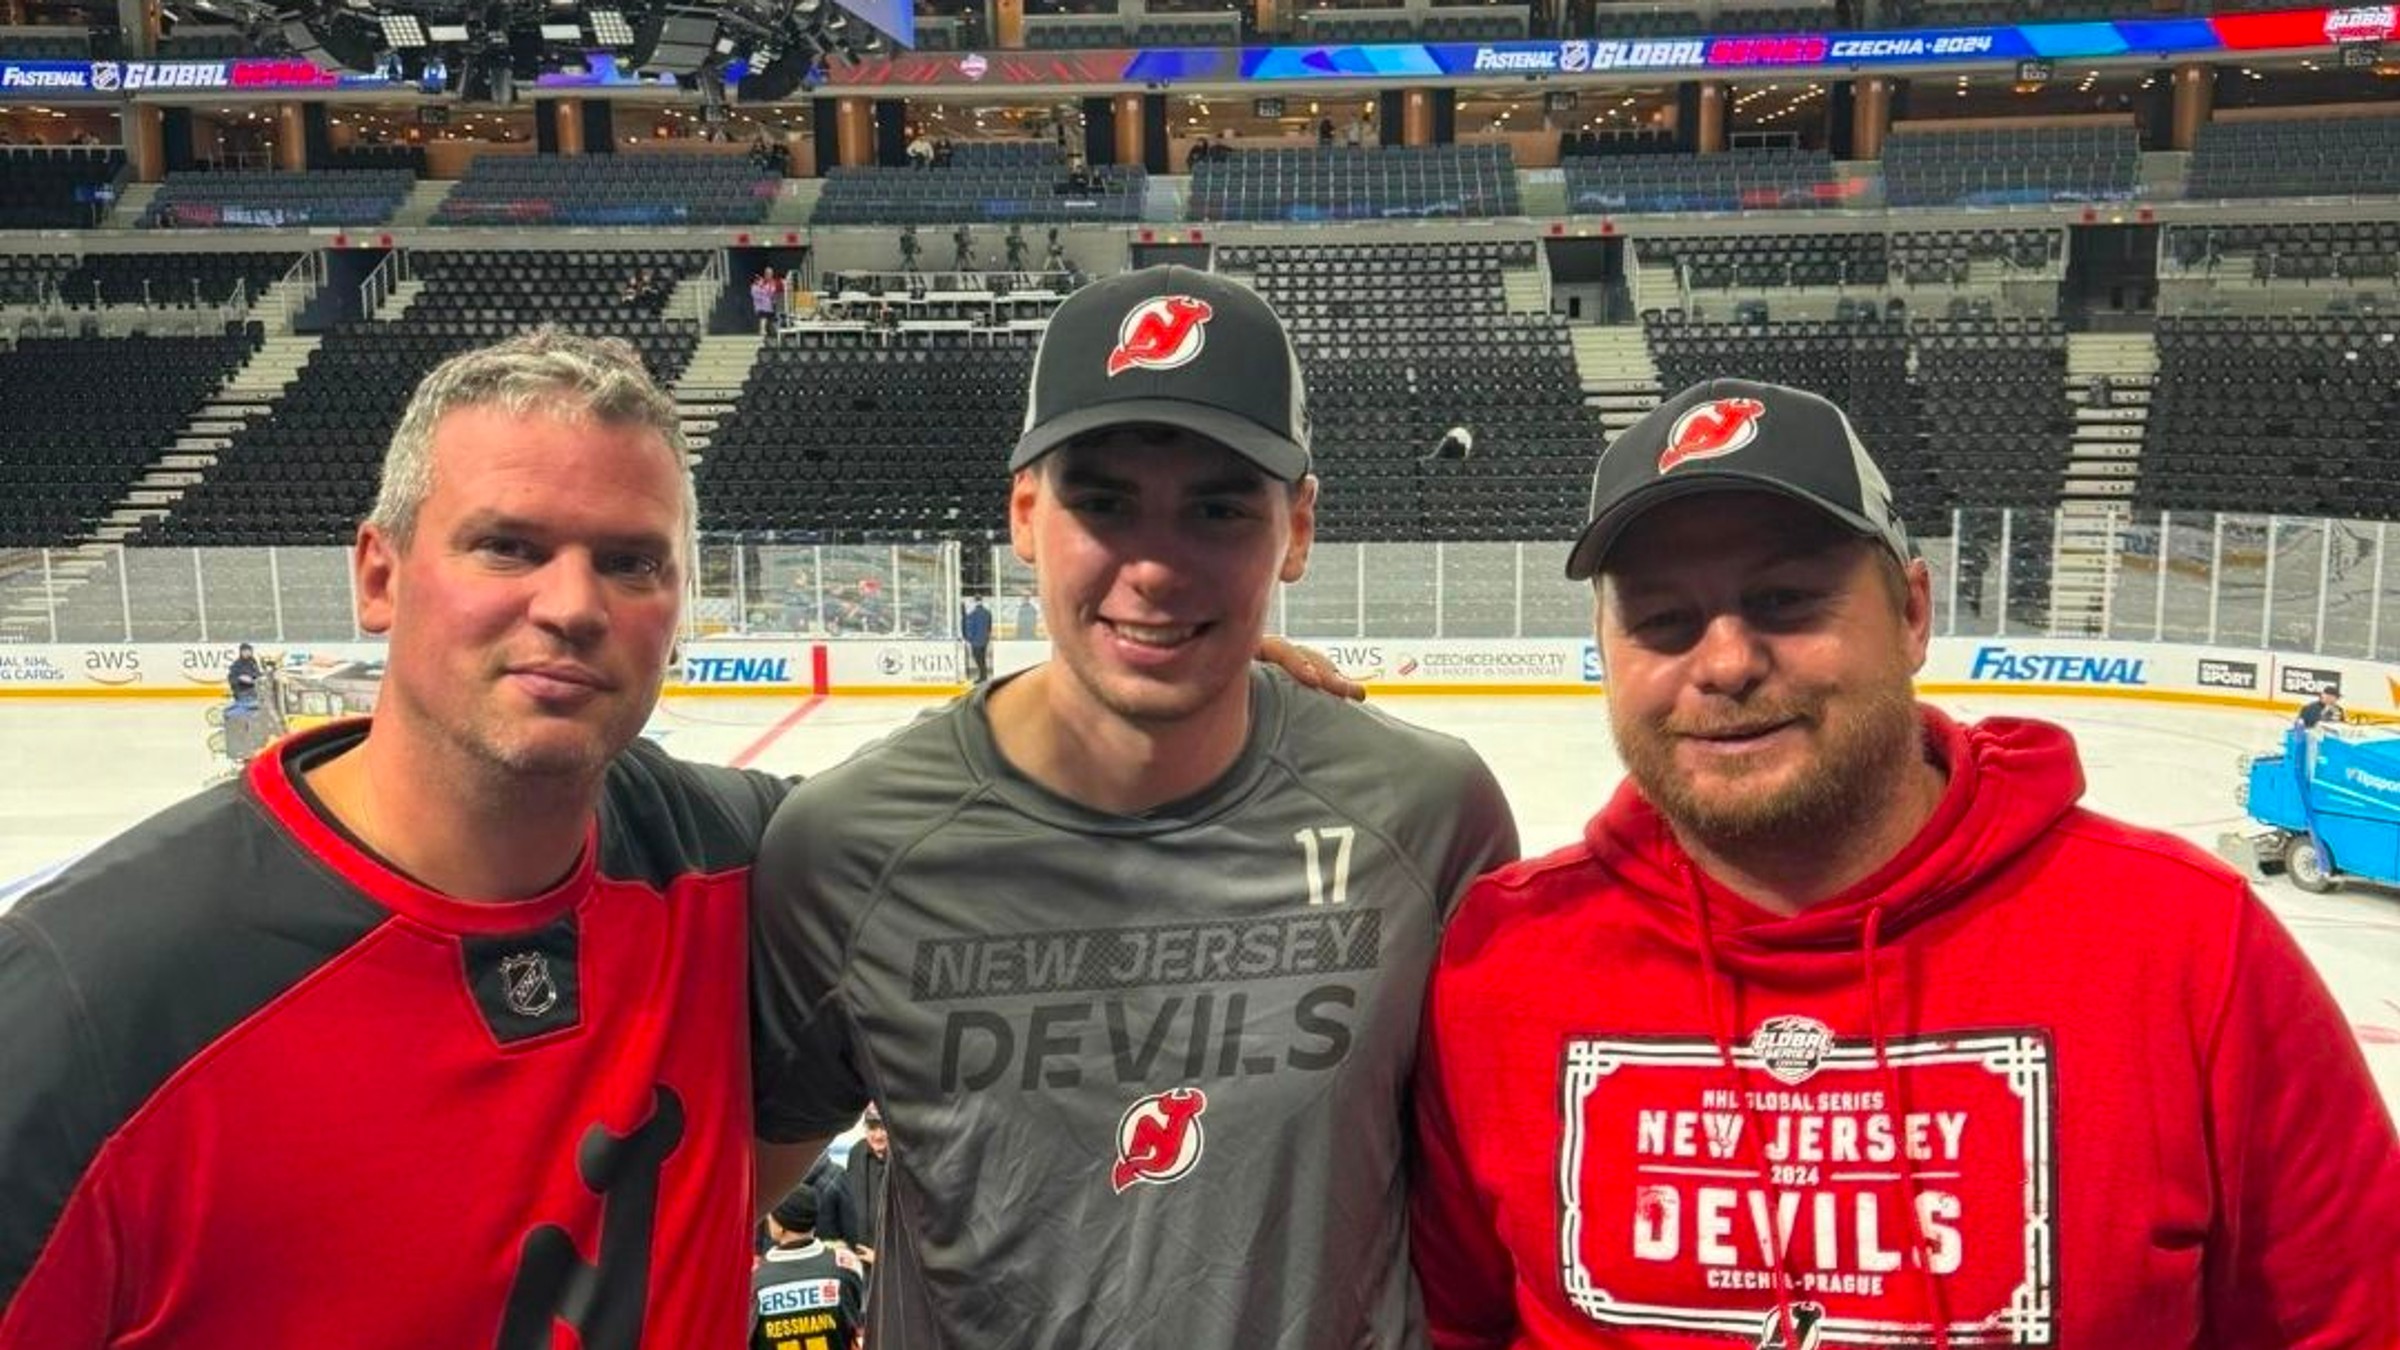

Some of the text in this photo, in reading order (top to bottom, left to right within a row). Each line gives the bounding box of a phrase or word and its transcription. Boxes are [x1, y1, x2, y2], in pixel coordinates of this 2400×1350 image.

[1474, 48, 1557, 69] FASTENAL
[1592, 42, 1704, 69] GLOBAL
[2, 66, 86, 86] FASTENAL
[124, 64, 227, 88] GLOBAL
[86, 650, 139, 669] aws
[183, 650, 236, 669] aws
[1329, 647, 1382, 667] aws
[1970, 647, 2147, 685] FASTENAL
[15, 669, 64, 680] CARDS
[2201, 670, 2253, 686] SPORT
[1294, 826, 1355, 904] 17
[928, 914, 1366, 994] NEW JERSEY
[939, 984, 1358, 1093] DEVILS
[1752, 1031, 1832, 1054] GLOBAL
[1703, 1090, 1739, 1109] NHL
[1817, 1092, 1884, 1111] SERIES
[1637, 1109, 1968, 1162] NEW JERSEY
[1771, 1165, 1820, 1186] 2024
[1633, 1185, 1962, 1275] DEVILS
[762, 1286, 820, 1311] ERSTE
